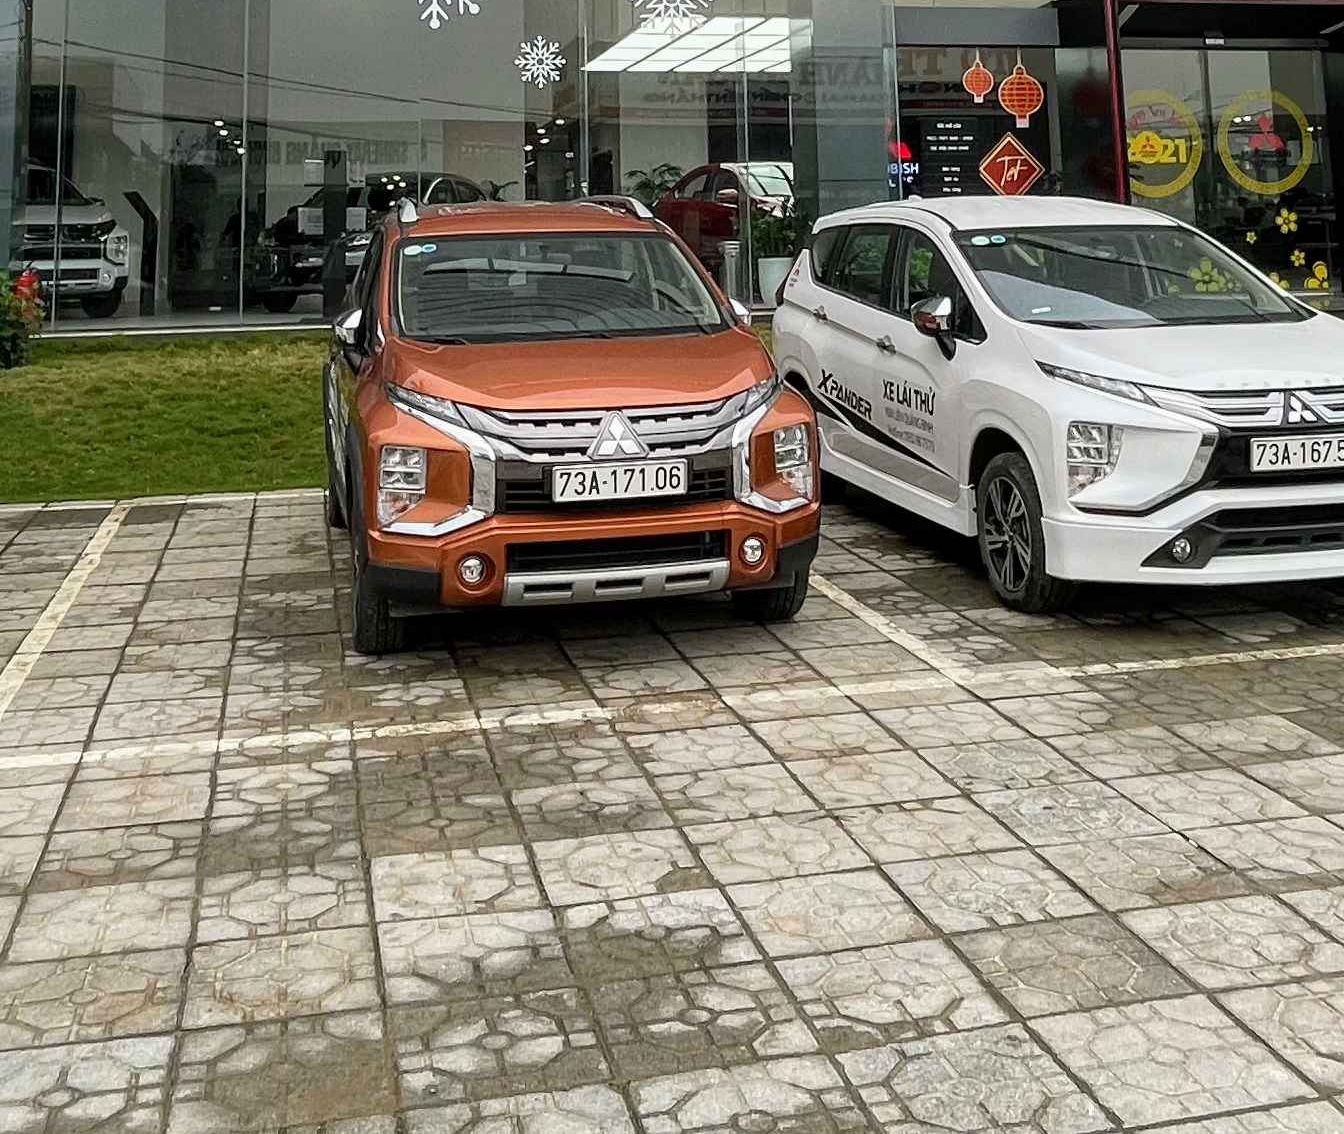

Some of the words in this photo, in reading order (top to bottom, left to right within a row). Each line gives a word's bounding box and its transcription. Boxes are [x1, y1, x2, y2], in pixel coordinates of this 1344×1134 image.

[817, 369, 873, 421] XPANDER
[882, 379, 895, 402] XE
[896, 380, 912, 408] LÁI
[913, 386, 936, 416] THỬ
[559, 466, 681, 498] 73A-171.06
